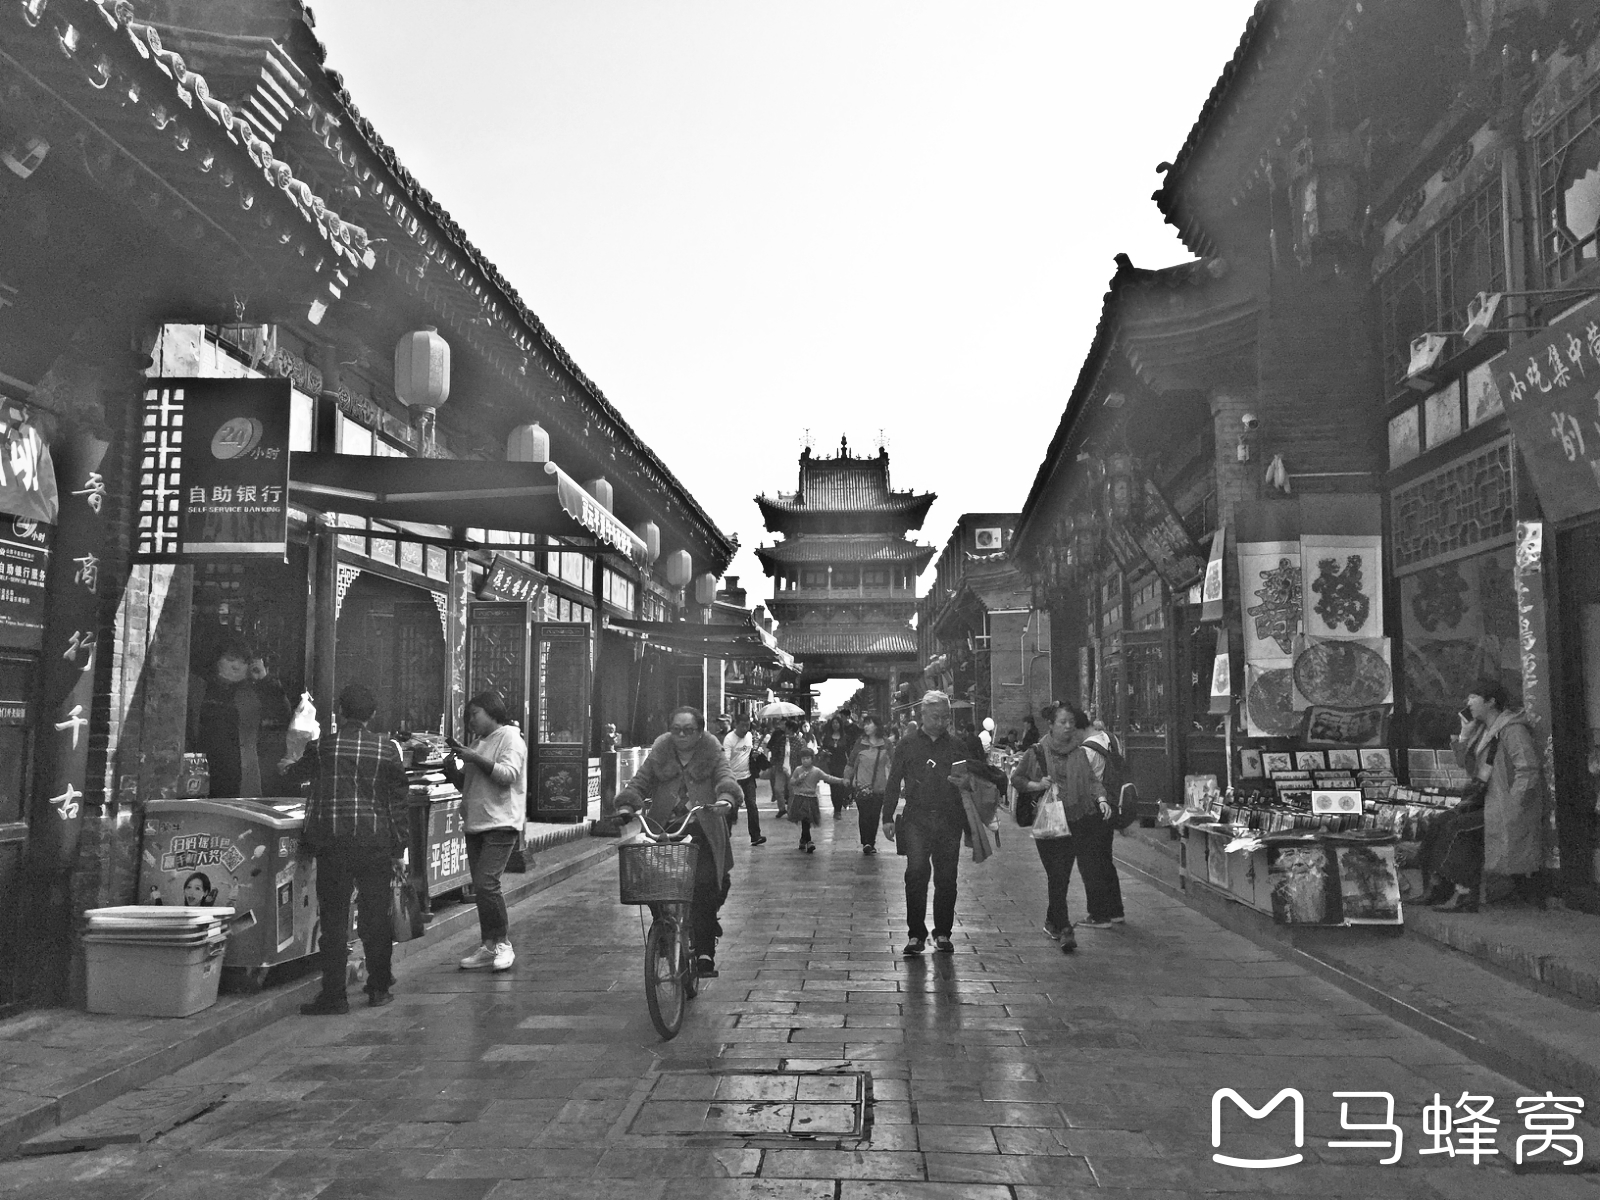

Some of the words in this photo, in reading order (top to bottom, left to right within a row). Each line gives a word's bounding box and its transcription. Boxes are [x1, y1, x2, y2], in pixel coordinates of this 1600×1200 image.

[250, 446, 279, 460] 小时
[189, 485, 283, 503] 自助银行
[188, 505, 208, 513] SELF
[430, 836, 468, 880] 平遥散牛
